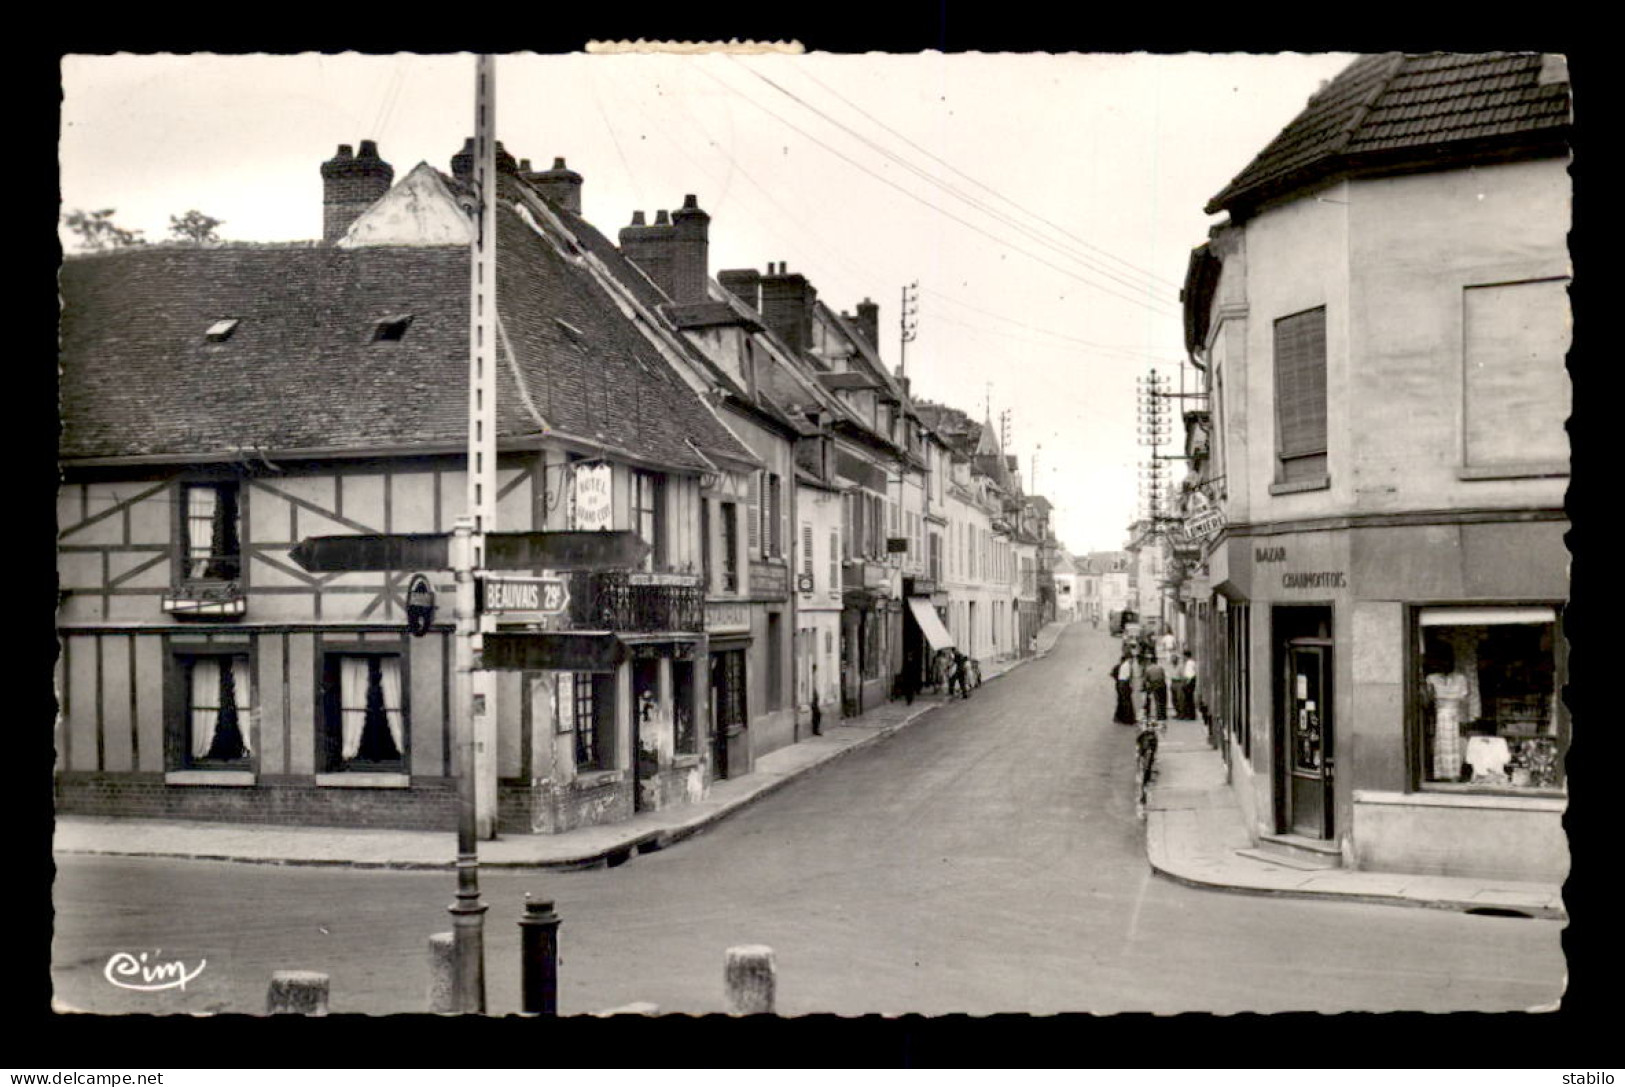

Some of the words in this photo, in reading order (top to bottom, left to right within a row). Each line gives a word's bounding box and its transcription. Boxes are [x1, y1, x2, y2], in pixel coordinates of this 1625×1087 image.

[579, 477, 607, 496] HOTEL
[1255, 546, 1287, 563] BAZAR
[487, 583, 538, 609] BEAUVAIS
